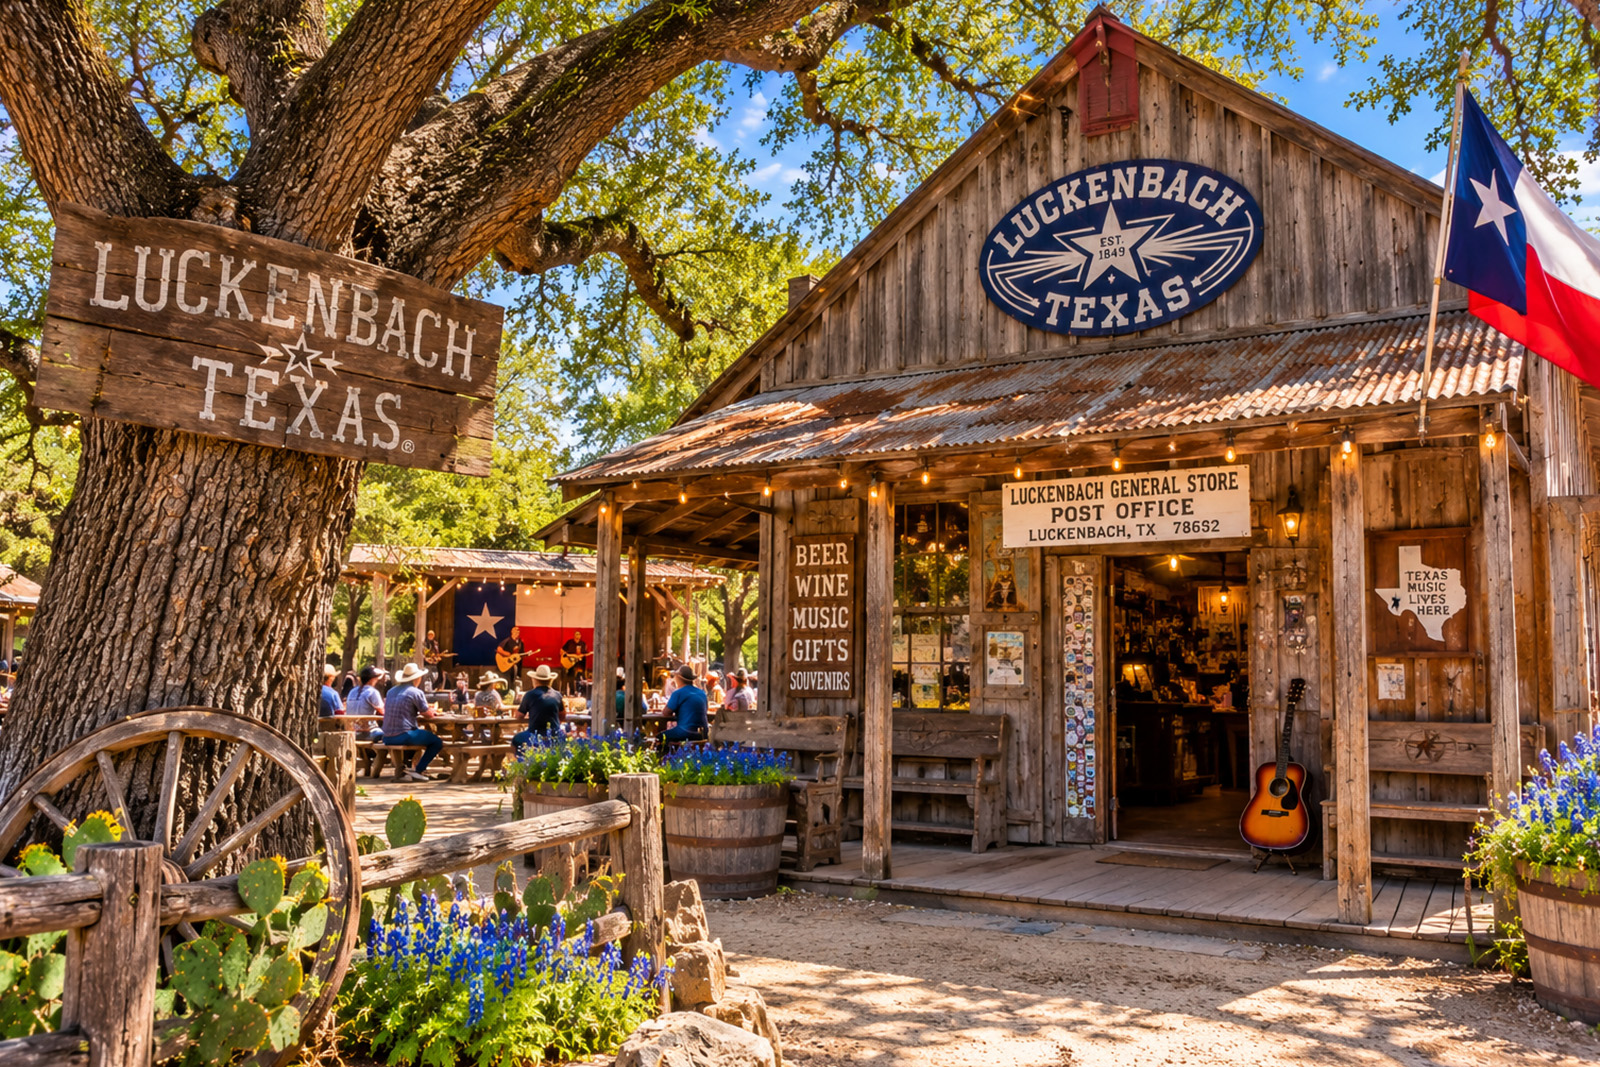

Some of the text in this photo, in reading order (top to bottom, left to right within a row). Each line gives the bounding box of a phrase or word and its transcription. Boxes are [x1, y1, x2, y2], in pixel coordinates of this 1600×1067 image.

[993, 166, 1245, 258] LUCKENBACH
[1100, 235, 1124, 247] EST.
[1099, 246, 1126, 260] 1849
[89, 241, 476, 382] LUCKENBACH
[1045, 275, 1190, 329] TEXAS
[1011, 472, 1239, 506] LUCKENBACH GENERAL STORE
[1051, 498, 1194, 523] POST OFFICE
[1029, 524, 1131, 541] LUCKENBACH,
[1136, 523, 1156, 536] TX
[795, 542, 849, 566] BEER
[795, 574, 849, 597] WINE
[1405, 571, 1448, 581] TEXAS
[1407, 582, 1446, 592] MUSIC
[1409, 594, 1446, 604] LIVES
[792, 606, 849, 629] MUSIC
[1417, 606, 1450, 615] HERE
[792, 639, 848, 661] GIFTS
[790, 671, 850, 690] SOUVENIRS
